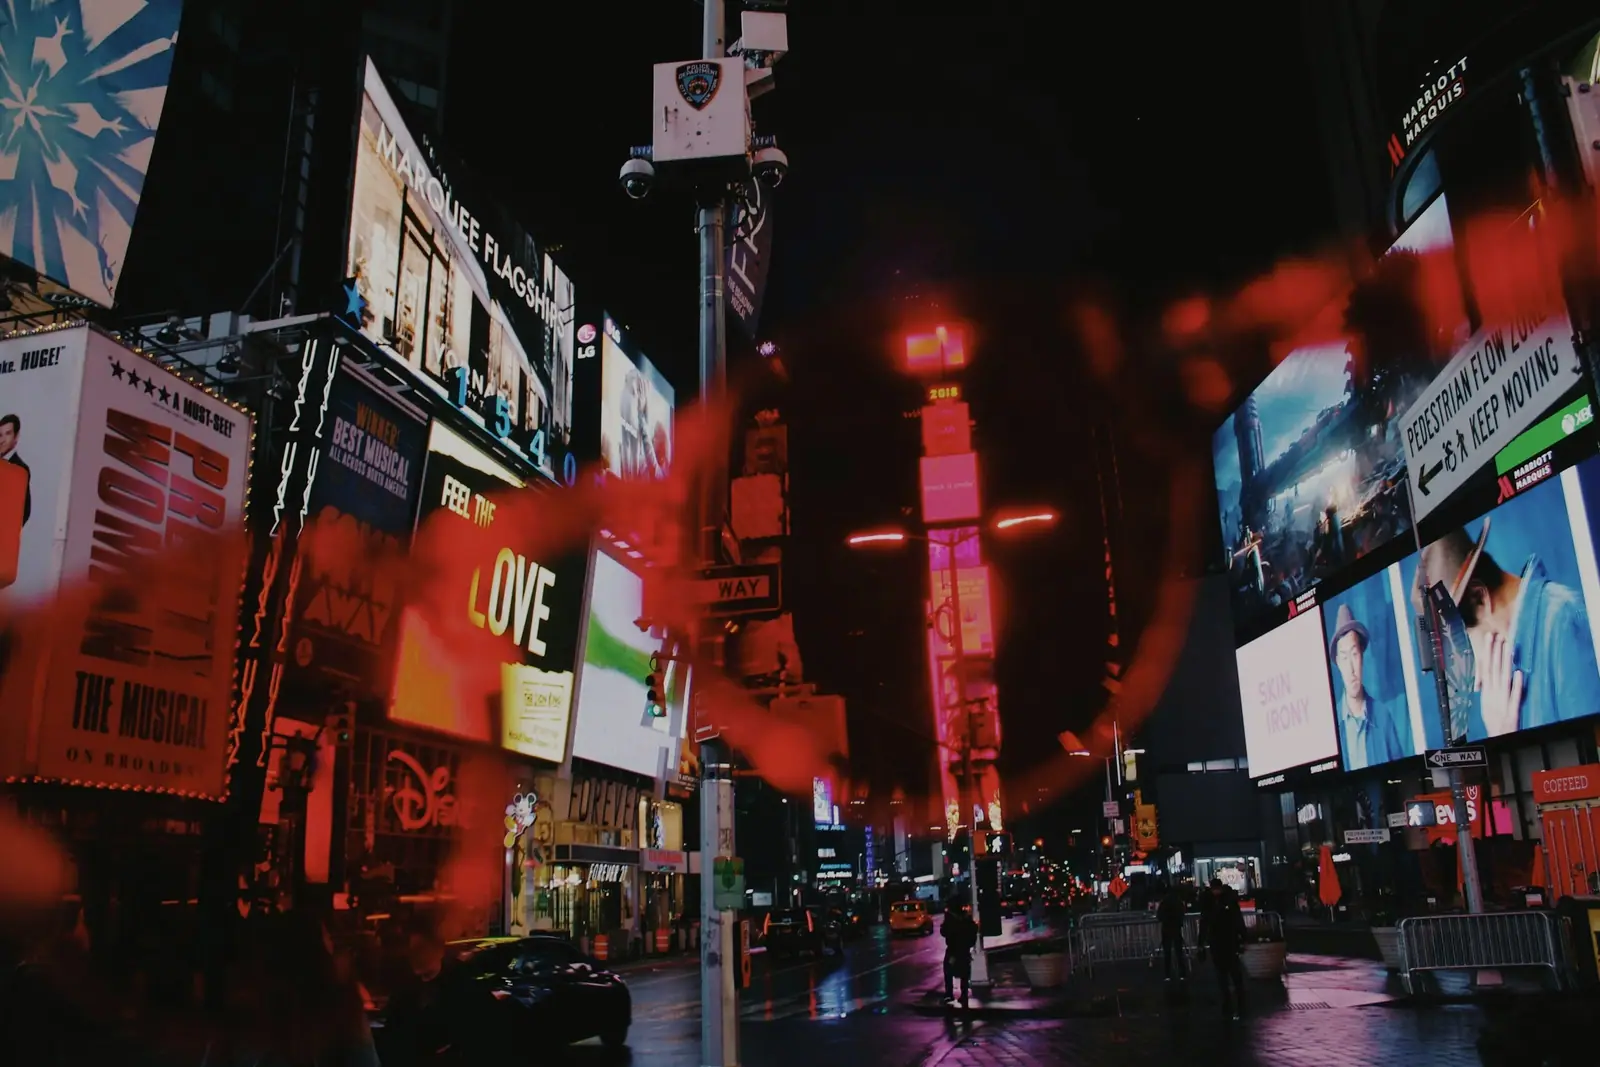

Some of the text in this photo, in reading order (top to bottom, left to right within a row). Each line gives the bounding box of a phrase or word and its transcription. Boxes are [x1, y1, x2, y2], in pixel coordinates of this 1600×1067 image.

[686, 63, 710, 71] POLICE
[1403, 56, 1468, 129] MARRIOTT
[1405, 81, 1463, 146] MARQUIS
[376, 121, 565, 338] MARQUEE FLAGSHIPS
[577, 345, 596, 359] LG
[172, 392, 180, 411] A
[930, 387, 958, 400] 2018
[1407, 367, 1472, 458] PEDESTRIAN
[1470, 329, 1507, 391] FLOW
[1469, 336, 1559, 450] KEEP MOVING
[332, 415, 410, 486] BEST MUSICAL
[1514, 450, 1552, 479] MARRIOTT
[328, 444, 341, 463] ALL
[341, 451, 367, 476] ACROSS
[384, 475, 408, 501] AMERICA
[1516, 464, 1551, 490] MARQUIS
[441, 473, 472, 520] FEEL
[468, 547, 556, 657] LOVE
[718, 578, 760, 598] WAY
[1258, 671, 1292, 705] SKIN
[73, 671, 208, 751] THE MUSICAL
[1267, 698, 1309, 735] IRONY
[66, 747, 93, 764] ON
[1434, 751, 1478, 763] ONE WAY
[1543, 775, 1588, 794] COFFEED
[588, 863, 621, 883] FOREVER
